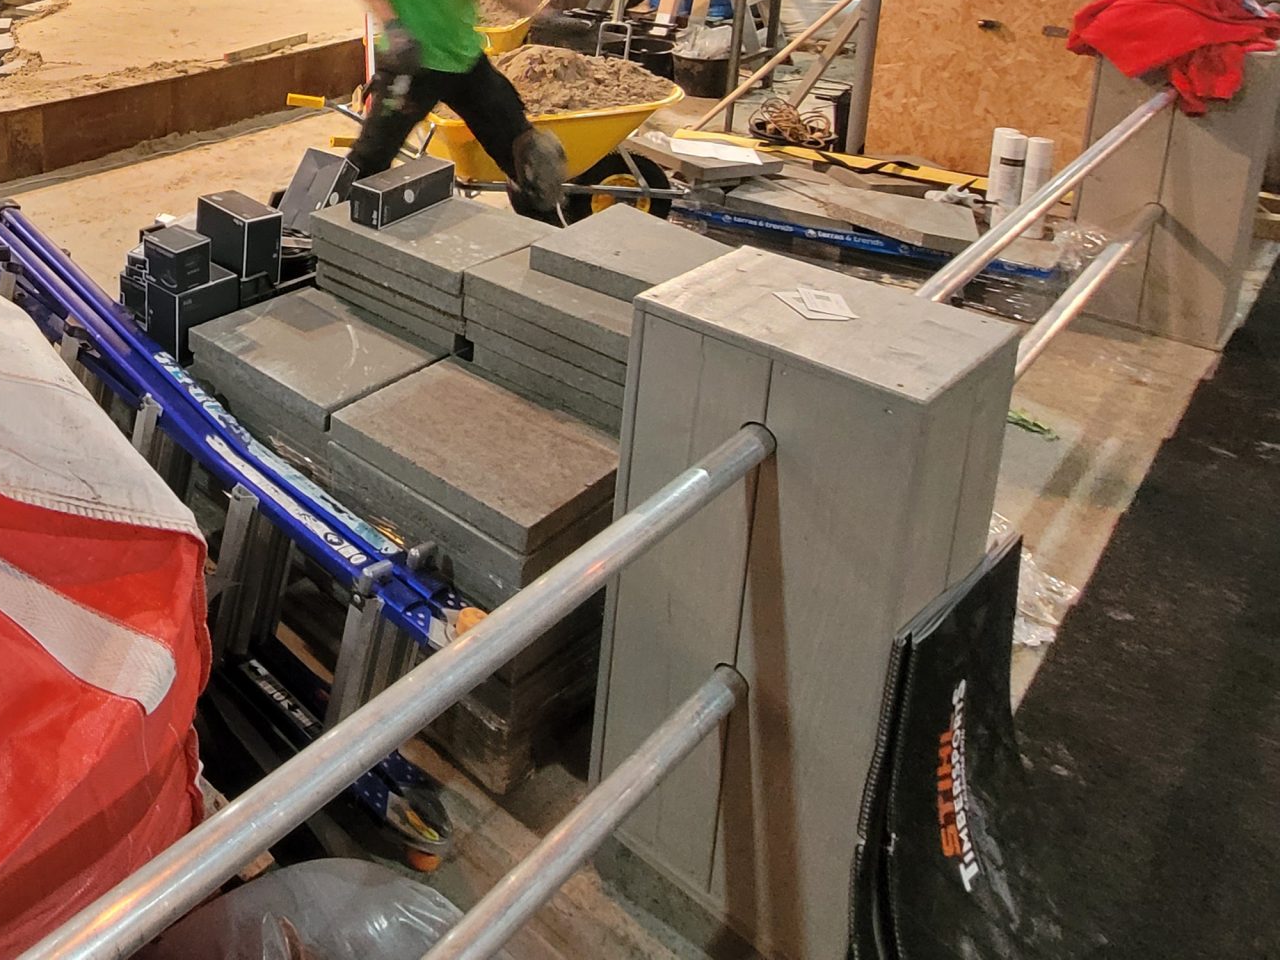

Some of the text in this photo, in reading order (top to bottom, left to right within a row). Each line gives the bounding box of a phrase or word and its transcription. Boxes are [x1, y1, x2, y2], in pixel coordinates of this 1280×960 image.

[733, 215, 757, 227] terras
[765, 221, 795, 233] trends
[817, 230, 844, 241] terras
[853, 235, 885, 247] trends
[952, 679, 980, 892] TIMBERSPORTS
